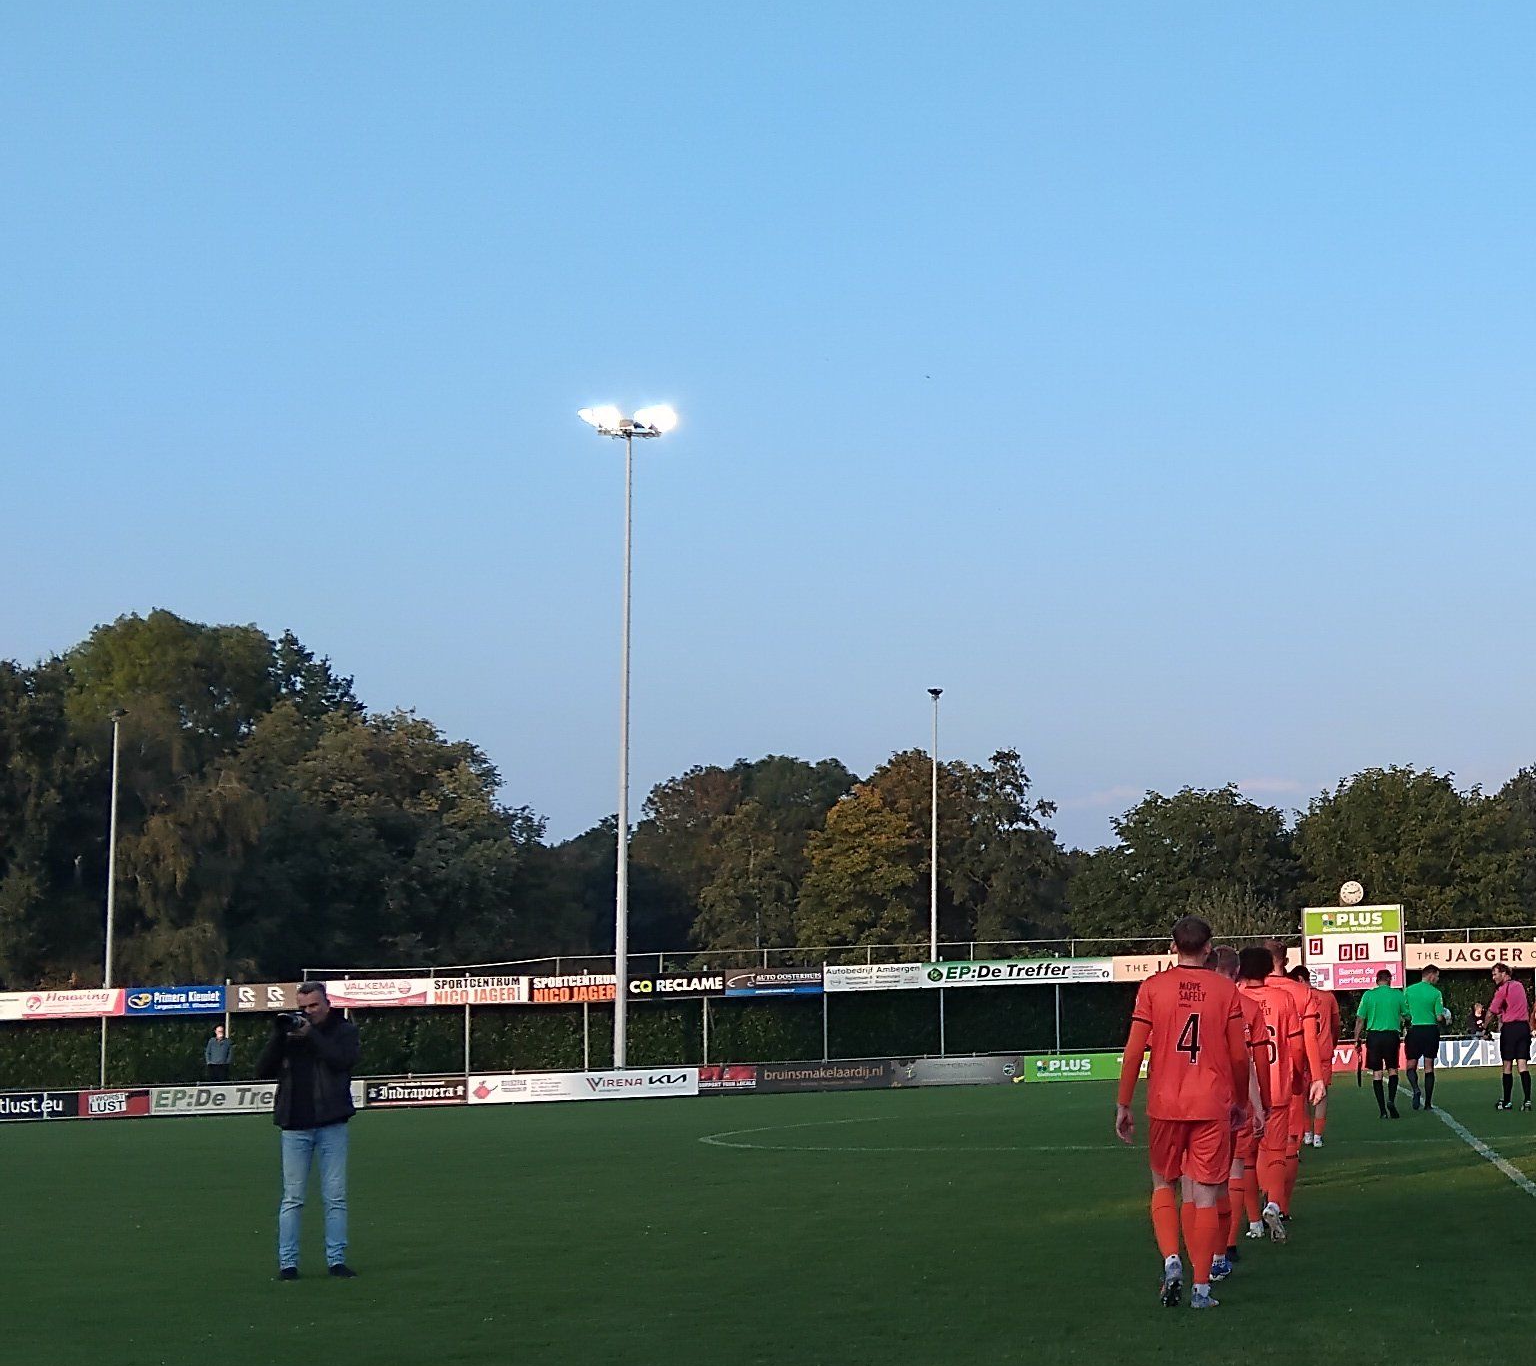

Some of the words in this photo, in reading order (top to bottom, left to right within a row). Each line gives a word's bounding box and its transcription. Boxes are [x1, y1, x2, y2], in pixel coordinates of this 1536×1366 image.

[1336, 912, 1383, 926] PLUS
[1417, 952, 1440, 960] THE
[1446, 948, 1522, 962] JAGGER
[946, 965, 1002, 980] EP:De
[1006, 963, 1070, 978] Treffer
[1125, 964, 1149, 973] THE
[344, 982, 396, 990] VALKEMA
[434, 977, 520, 990] SPORTCENTRUM
[656, 977, 723, 992] RECLAME
[1179, 981, 1202, 991] MOVE
[154, 992, 187, 1003] Primera
[434, 990, 469, 1004] NICO
[534, 988, 569, 1003] NICO
[572, 985, 616, 1001] JAGER
[1179, 991, 1207, 1002] SAFELY
[1176, 1013, 1201, 1065] 4
[1049, 1059, 1091, 1071] PLUS
[764, 1066, 884, 1081] bruinsmakelaardij.nl
[90, 1100, 125, 1113] LUST
